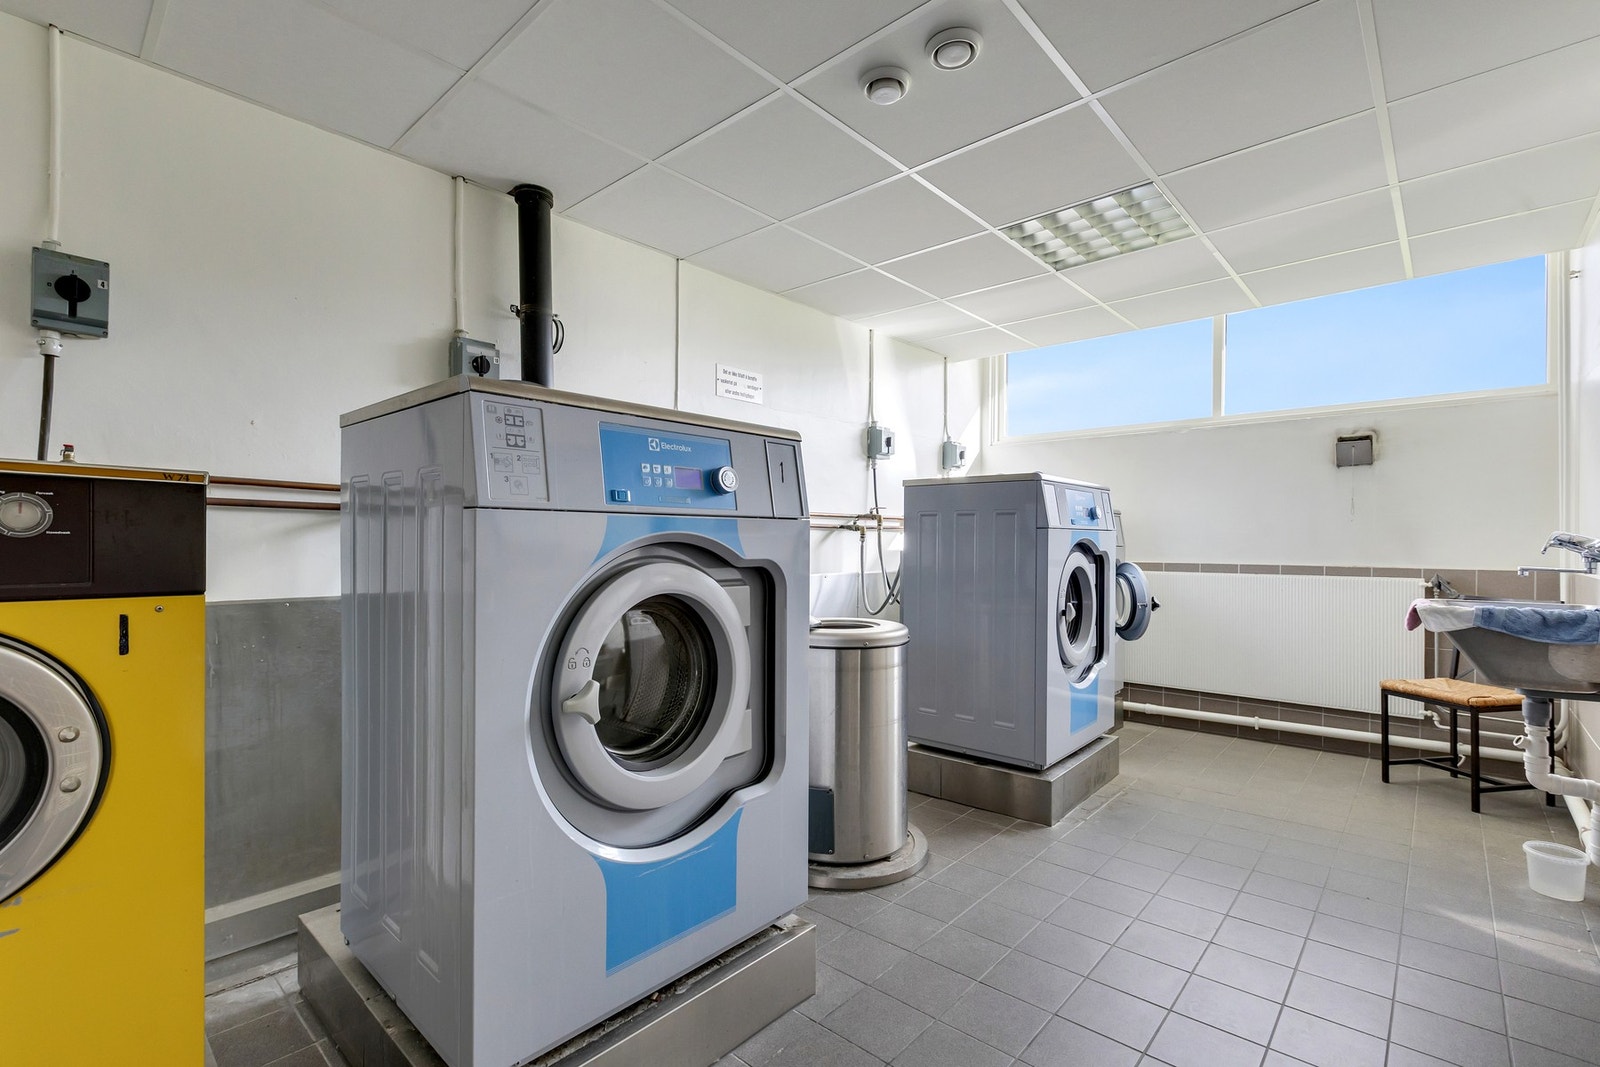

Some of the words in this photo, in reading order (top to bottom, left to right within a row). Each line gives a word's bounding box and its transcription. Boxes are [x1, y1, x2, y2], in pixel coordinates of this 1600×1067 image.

[660, 442, 692, 452] Electrolux
[516, 454, 521, 462] 2
[163, 472, 176, 481] W
[177, 473, 190, 482] 74
[504, 475, 509, 483] 3
